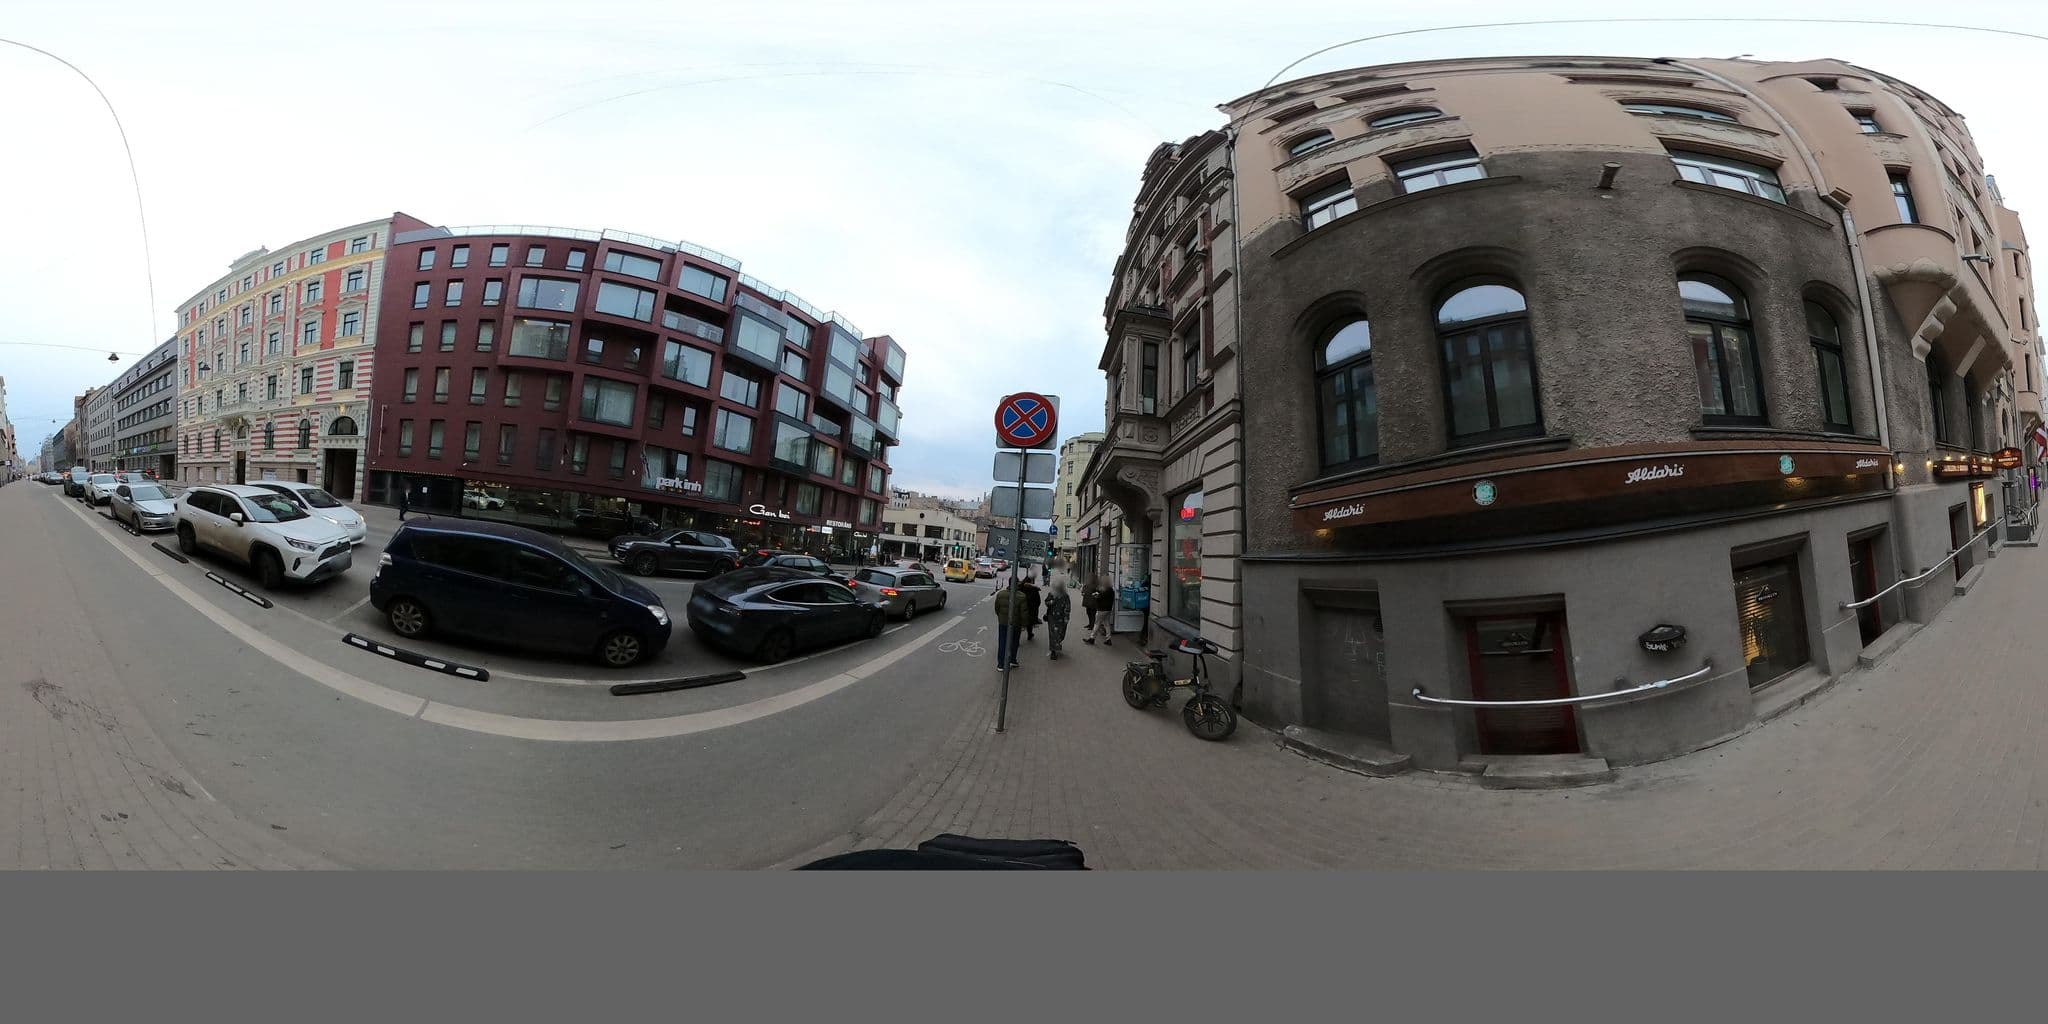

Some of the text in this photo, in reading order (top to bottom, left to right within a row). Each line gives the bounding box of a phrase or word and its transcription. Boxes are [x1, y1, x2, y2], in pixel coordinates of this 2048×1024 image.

[1856, 458, 1879, 469] Aldaris
[1624, 463, 1684, 485] Aldaris
[655, 477, 702, 492] park inn
[749, 504, 777, 518] Gan
[1322, 503, 1366, 521] Aldaris
